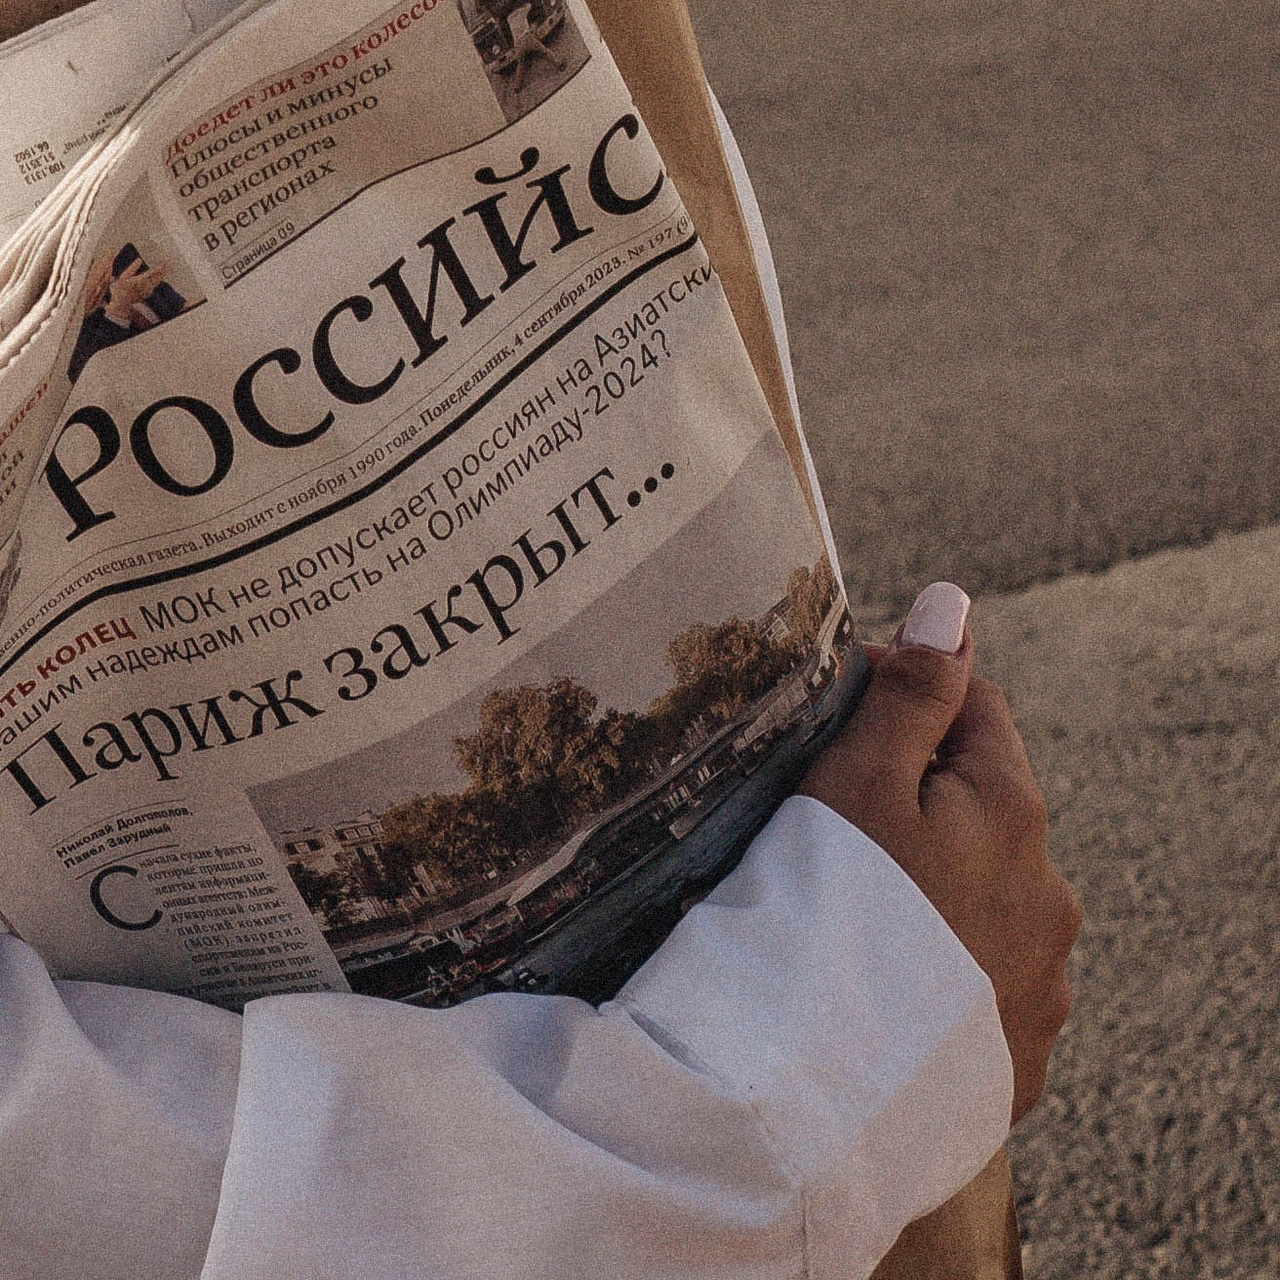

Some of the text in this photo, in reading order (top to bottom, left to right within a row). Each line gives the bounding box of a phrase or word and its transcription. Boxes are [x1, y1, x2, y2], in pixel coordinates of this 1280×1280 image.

[165, 100, 253, 164] Доедет
[260, 77, 295, 104] ли
[301, 54, 348, 87] это
[171, 57, 392, 177] Плюсы и минусы
[179, 93, 379, 198] общественного
[187, 136, 337, 223] транспорта
[204, 159, 336, 253] в регионах
[221, 221, 296, 281] Страница 09
[146, 539, 202, 564] газета.
[203, 508, 273, 546] Выходит
[276, 501, 287, 515] с
[288, 472, 347, 510] ноября
[349, 449, 384, 480] 1990
[385, 425, 420, 454] года.
[419, 343, 517, 427] Понедельник,
[513, 333, 524, 348] 4
[523, 282, 586, 339] сентября
[585, 256, 624, 291] 2023.
[627, 244, 645, 261] №
[648, 228, 672, 249] 197
[36, 616, 139, 679] КОЛЕЦ
[140, 587, 226, 634] МОК
[228, 577, 270, 608] не
[278, 478, 440, 595] допускает
[442, 388, 556, 497] россиян
[557, 356, 594, 397] на
[594, 262, 713, 367] Азиатски
[86, 623, 244, 681] надеждам
[249, 561, 383, 639] попасть
[386, 535, 428, 573] на
[428, 329, 673, 541] Олимпиаду-2024?
[324, 462, 675, 701] закрыт...
[56, 821, 114, 858] Николай
[63, 824, 171, 870] Павел Зарудный
